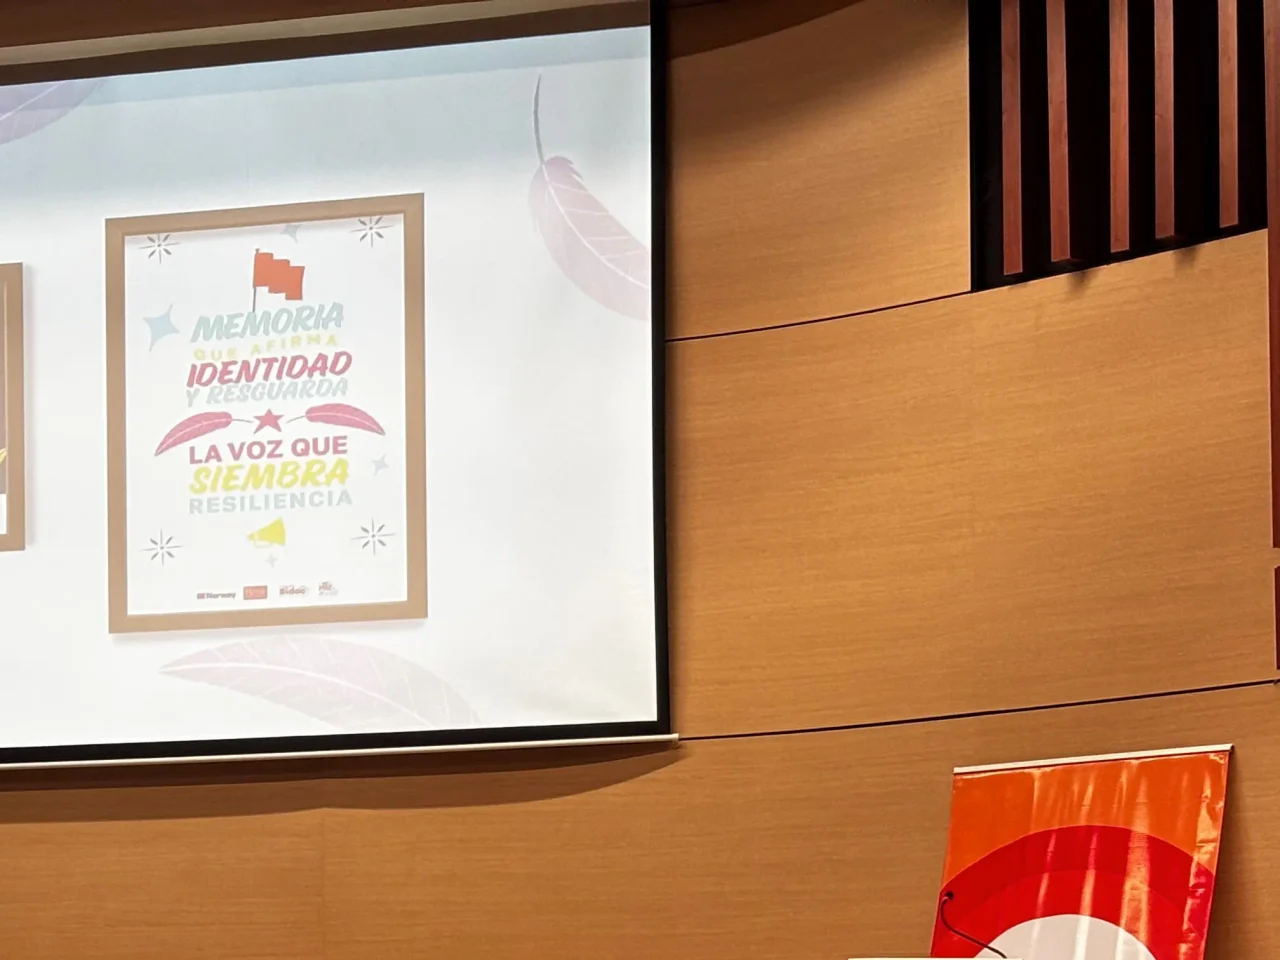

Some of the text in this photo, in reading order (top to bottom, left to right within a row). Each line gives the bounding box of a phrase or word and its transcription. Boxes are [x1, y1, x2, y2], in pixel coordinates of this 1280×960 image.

[190, 302, 344, 343] MEMORIA
[194, 334, 338, 361] QUE AFIRMA
[187, 351, 352, 388] IDENTIDAD
[186, 377, 349, 407] Y RESGUARDA
[189, 435, 348, 464] LA VOZ QUE
[189, 457, 349, 494] SIEMBRA
[189, 489, 353, 514] RESILIENCIA
